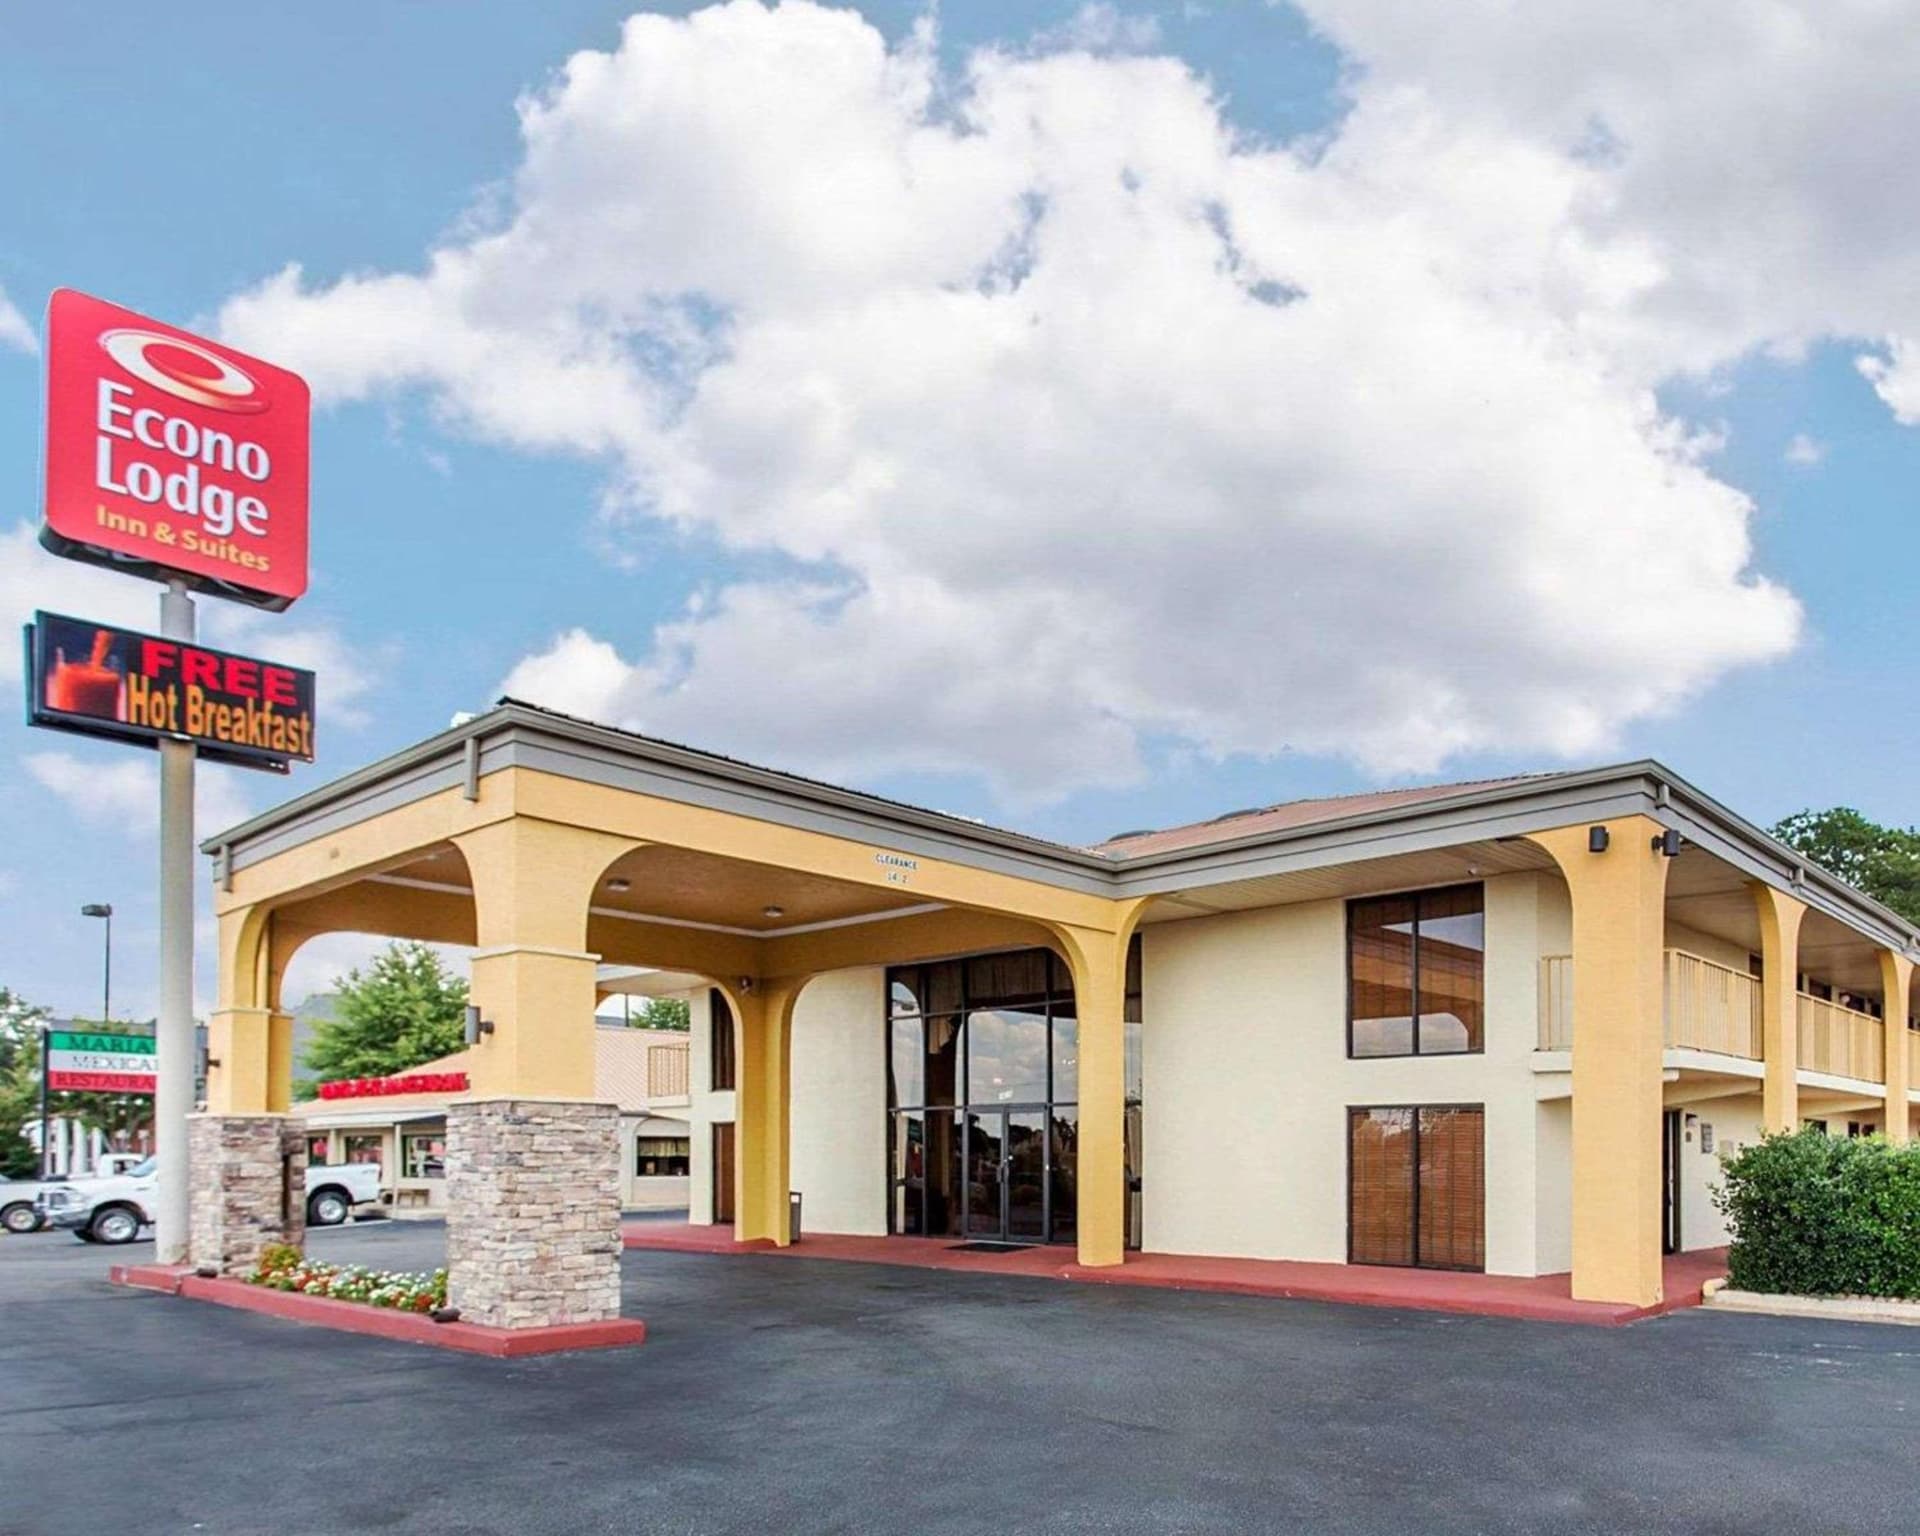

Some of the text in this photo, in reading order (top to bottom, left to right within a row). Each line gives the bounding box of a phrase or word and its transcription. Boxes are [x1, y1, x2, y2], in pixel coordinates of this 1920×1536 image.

[96, 377, 271, 481] Econo
[96, 436, 269, 536] Lodge
[97, 504, 270, 572] Inn & Suites
[142, 639, 297, 706] FREE
[126, 672, 312, 755] Hot Breakfast
[875, 853, 917, 870] CLEARANCE
[69, 1035, 155, 1054] MARIA
[72, 1055, 158, 1071] MEXICA
[55, 1073, 155, 1088] RESTAURA
